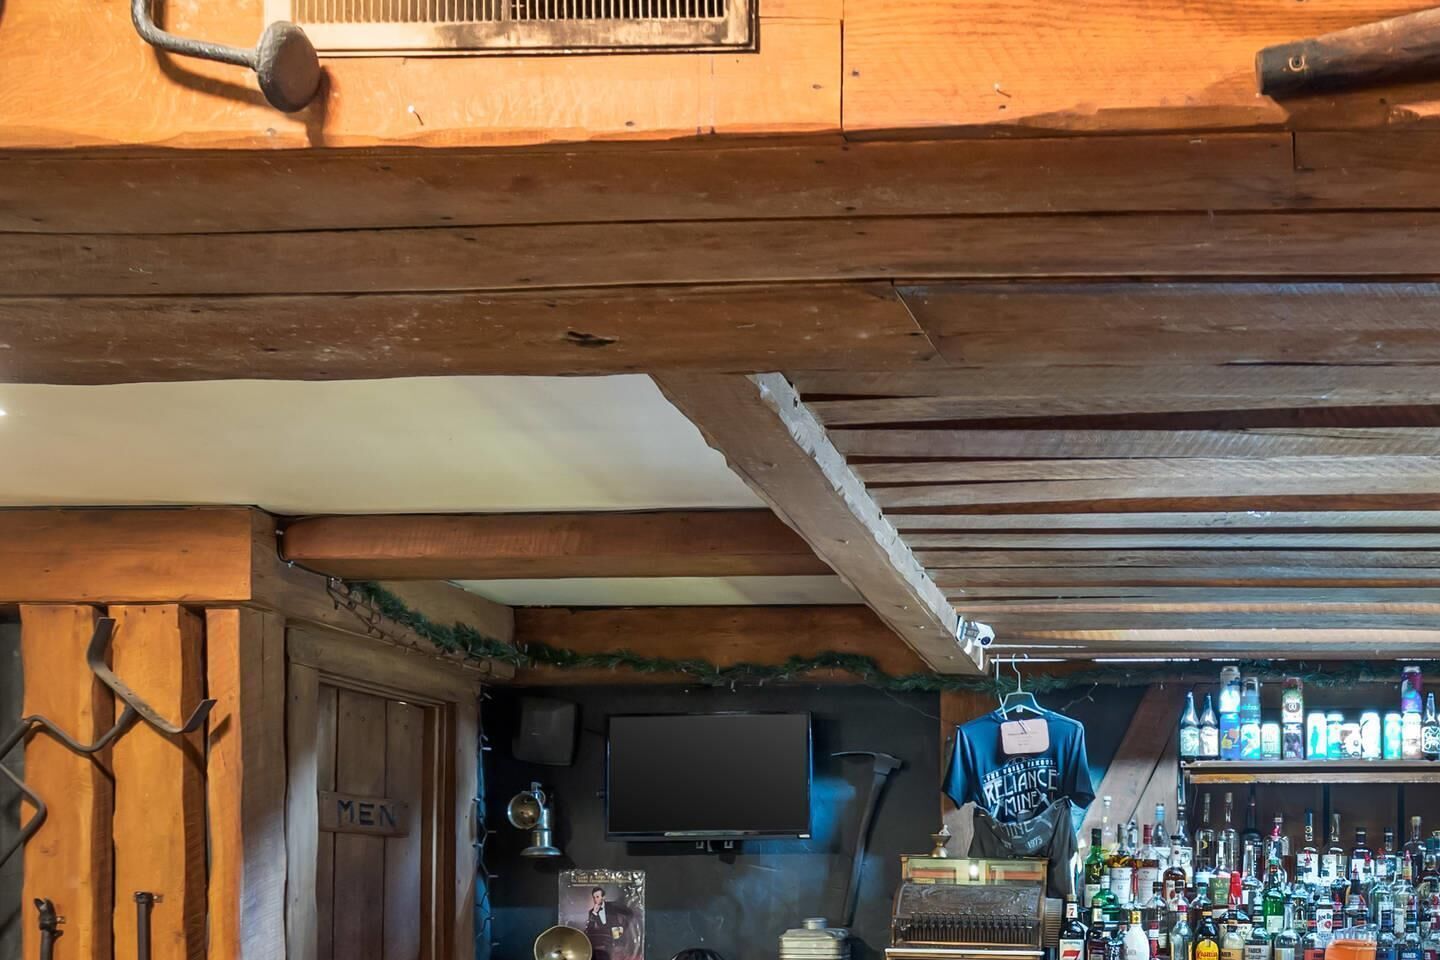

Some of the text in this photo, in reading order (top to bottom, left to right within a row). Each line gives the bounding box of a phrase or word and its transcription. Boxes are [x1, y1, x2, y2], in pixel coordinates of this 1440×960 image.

[983, 769, 1057, 808] RELIANCE
[337, 800, 398, 828] MEN
[1004, 790, 1039, 816] MINE
[1069, 907, 1076, 917] 7
